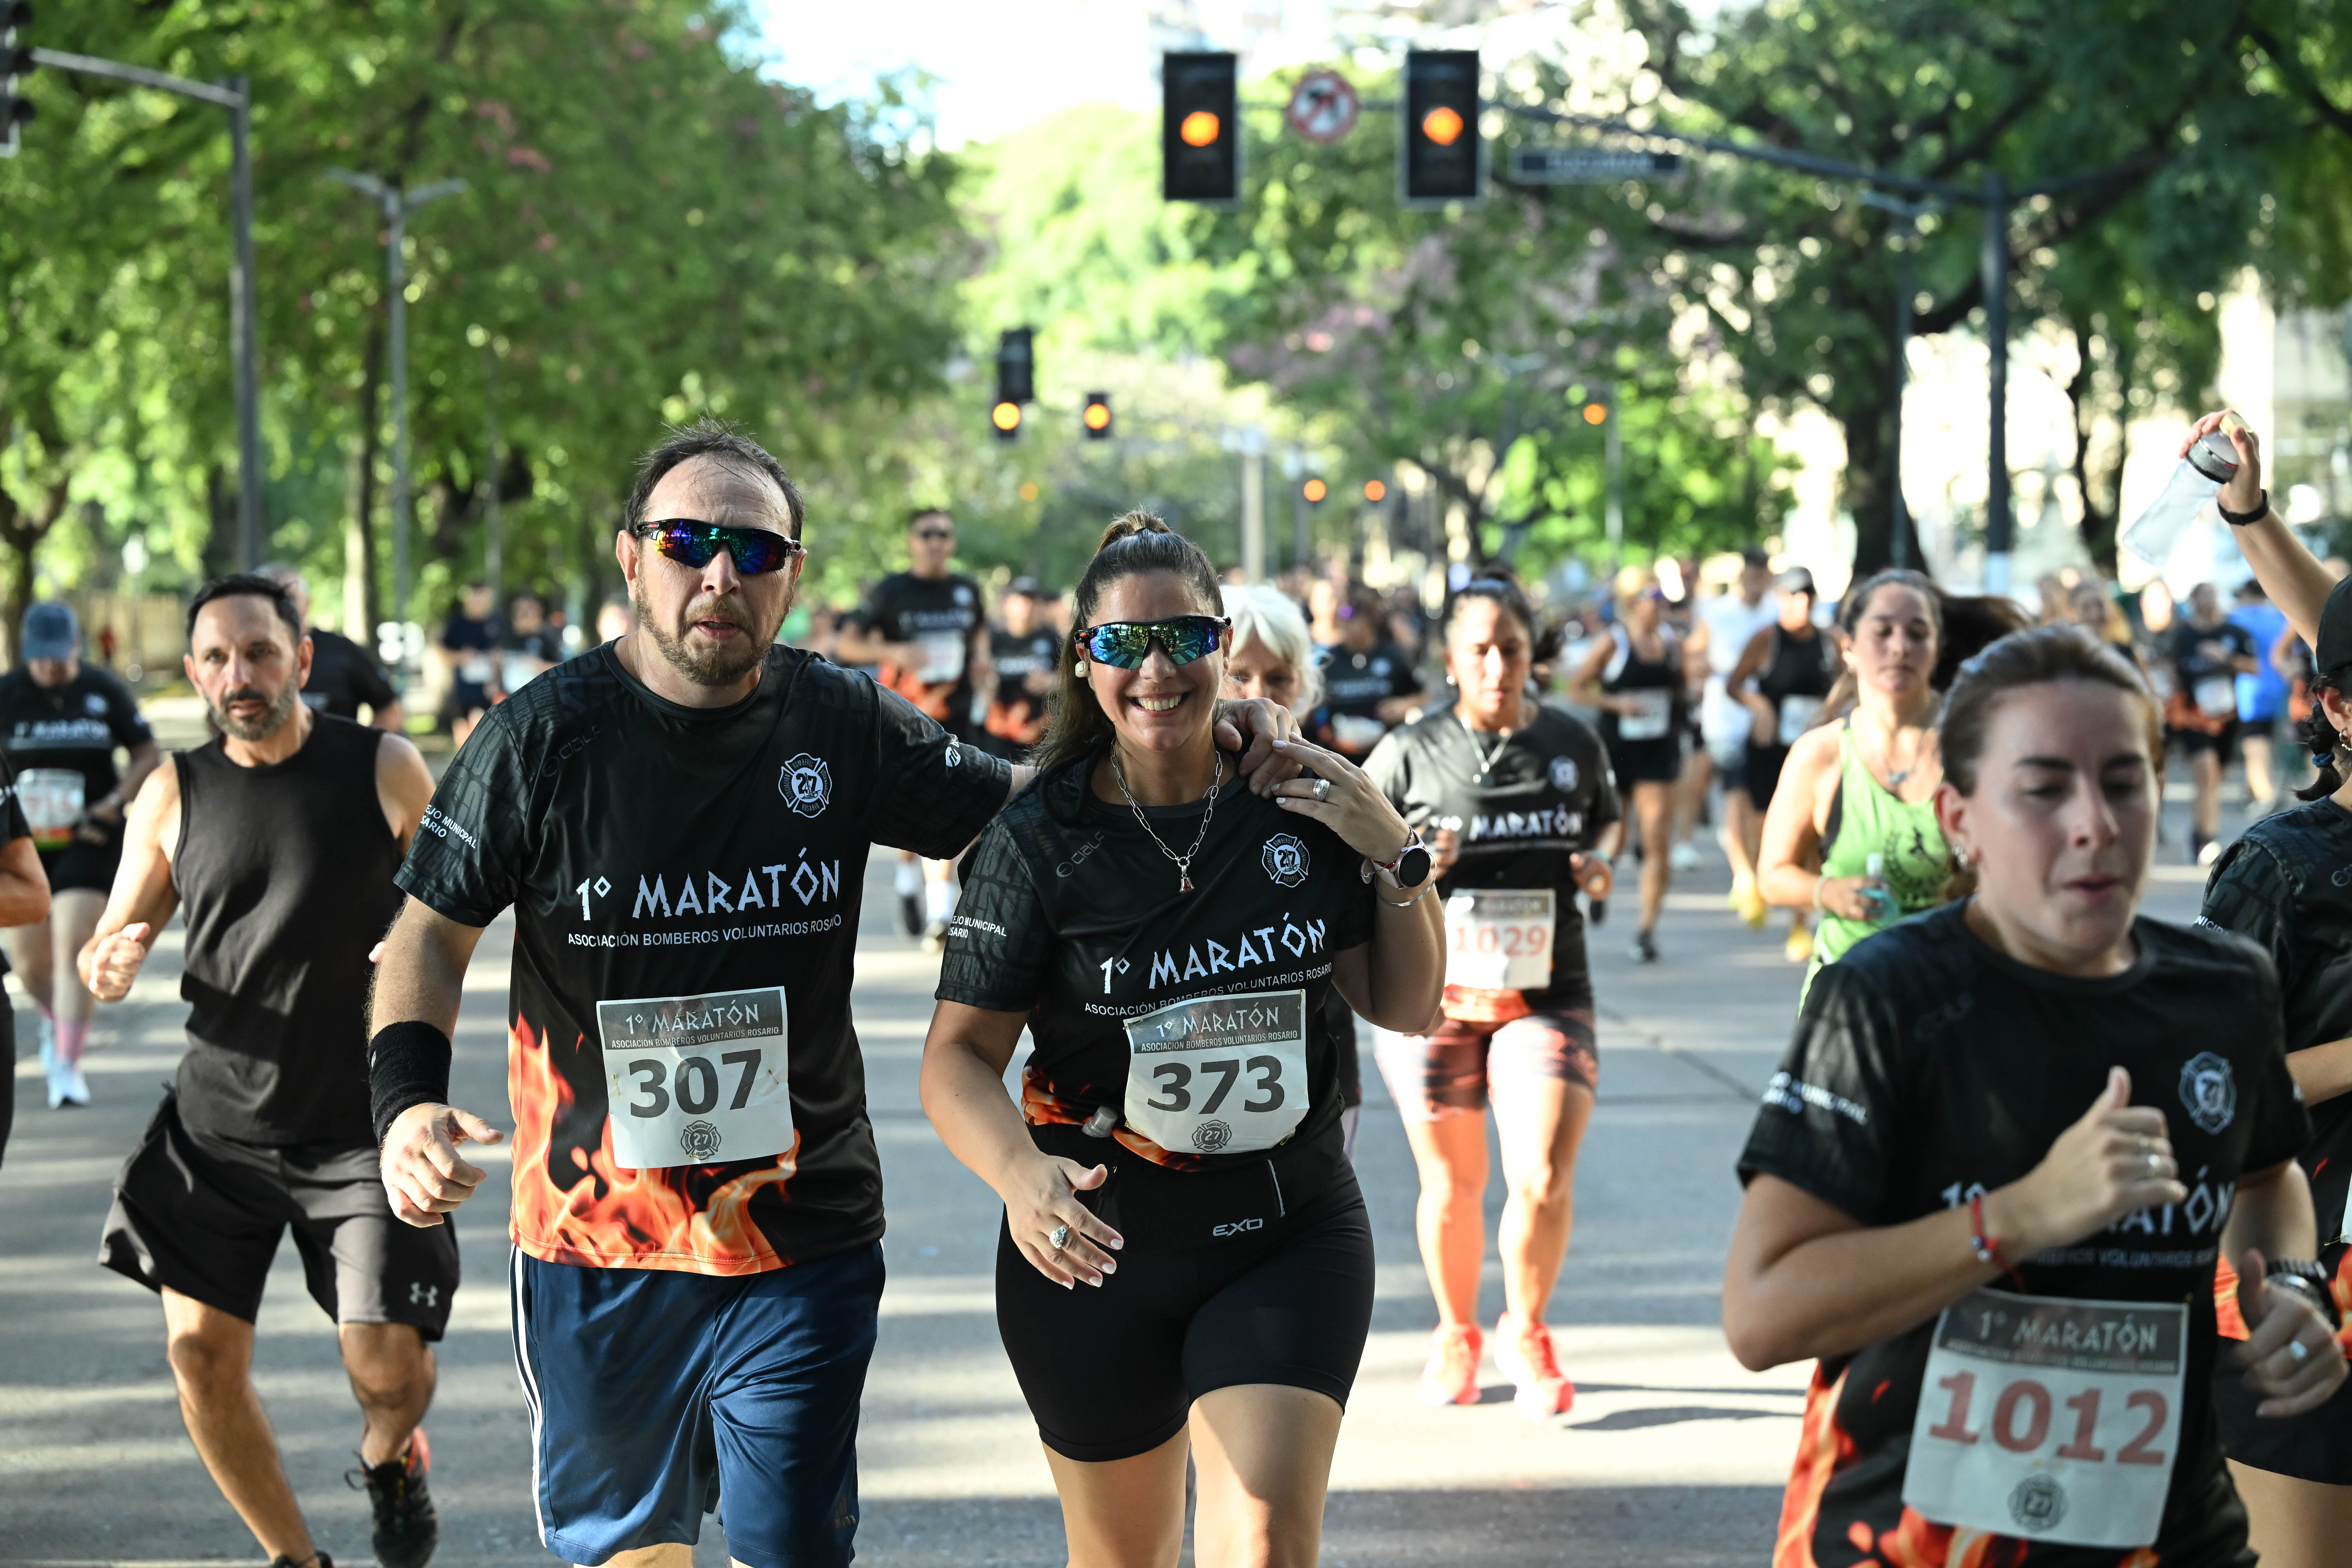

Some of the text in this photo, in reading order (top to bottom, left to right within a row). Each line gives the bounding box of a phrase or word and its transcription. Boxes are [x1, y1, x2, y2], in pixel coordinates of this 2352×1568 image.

[792, 759, 814, 769] BOMBEROS
[795, 773, 817, 794] 27
[802, 803, 820, 812] ROSARIO
[442, 816, 476, 849] MUNICIPAL
[1273, 838, 1293, 846] BOMBEROS
[1278, 850, 1296, 868] 27
[632, 847, 840, 920] MARATÓN
[568, 931, 639, 948] ASOCIACIÓN
[642, 930, 719, 946] BOMBEROS
[722, 921, 808, 941] VOLUNTARIOS
[964, 916, 1007, 937] MUNICIPAL
[1149, 912, 1326, 989] MARATÓN
[1454, 925, 1547, 956] 1029
[1085, 1002, 1156, 1016] ASOCIACIÓN
[1227, 971, 1304, 993] VOLUNTARIOS
[1307, 962, 1332, 980] ROSARIO
[652, 999, 759, 1033] MARATÓN
[1183, 1002, 1279, 1035] MARATÓN
[612, 1027, 779, 1048] ASOCIACIÓN BOMBEROS VOLUNTARIOS ROSARIO
[1186, 1038, 1222, 1049] BOMBEROS
[1223, 1033, 1266, 1045] VOLUNTARIOS
[1268, 1030, 1298, 1040] ROSARIO
[628, 1049, 761, 1118] 307
[1147, 1055, 1285, 1115] 373
[693, 1132, 709, 1146] 27
[1205, 1130, 1220, 1141] 27
[1212, 1218, 1263, 1237] EXO
[2012, 1312, 2159, 1354] MARATÓN
[1928, 1368, 2169, 1467] 1012
